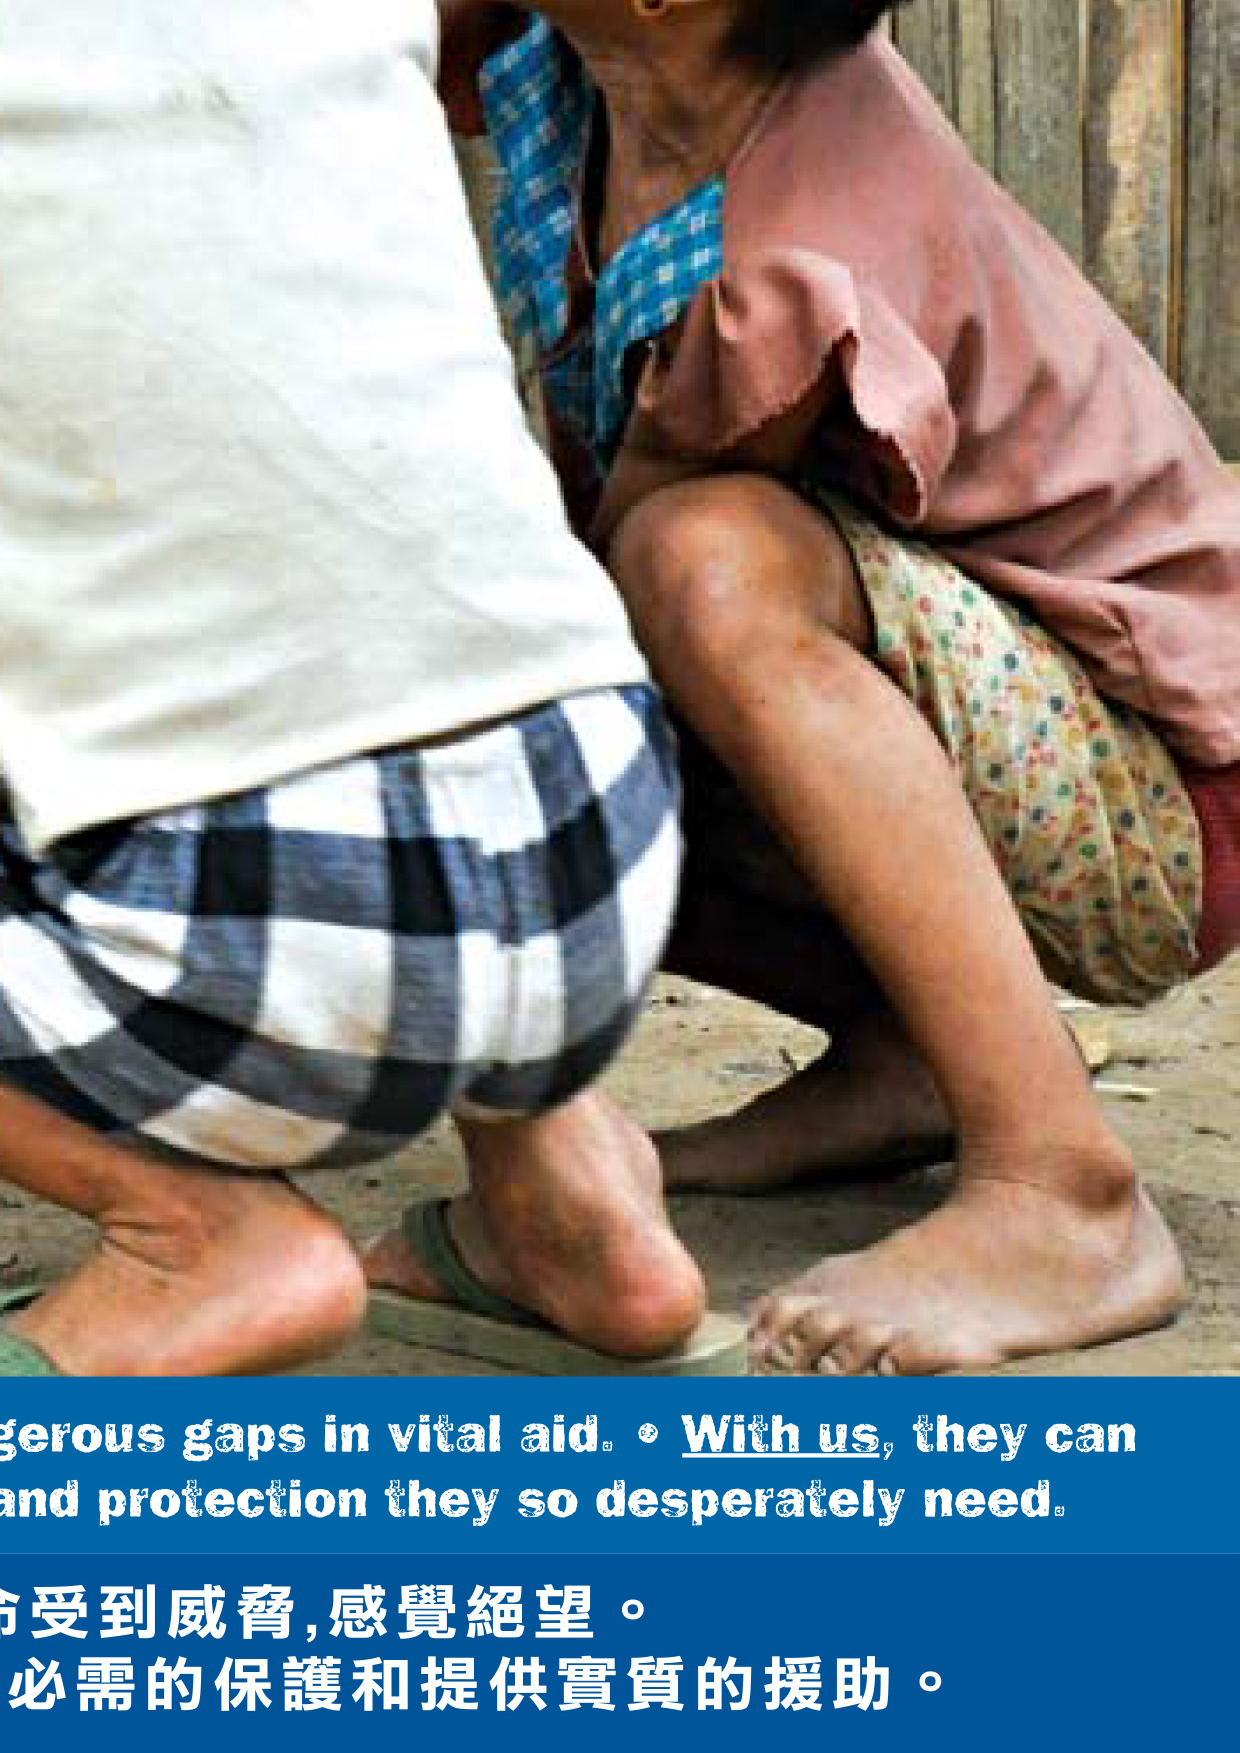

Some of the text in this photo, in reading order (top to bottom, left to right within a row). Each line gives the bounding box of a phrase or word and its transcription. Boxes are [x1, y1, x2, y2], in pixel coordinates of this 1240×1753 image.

[183, 1419, 305, 1459] gaps
[325, 1415, 369, 1452] in
[388, 1415, 500, 1452] vital
[521, 1415, 612, 1452] aid.
[681, 1415, 799, 1452] With
[820, 1424, 893, 1459] us,
[913, 1415, 1027, 1459] they
[1046, 1423, 1135, 1452] can
[99, 1480, 366, 1525] protection
[385, 1480, 499, 1526] they
[518, 1489, 578, 1517] so
[597, 1480, 905, 1526] desperately
[925, 1480, 1064, 1517] need.
